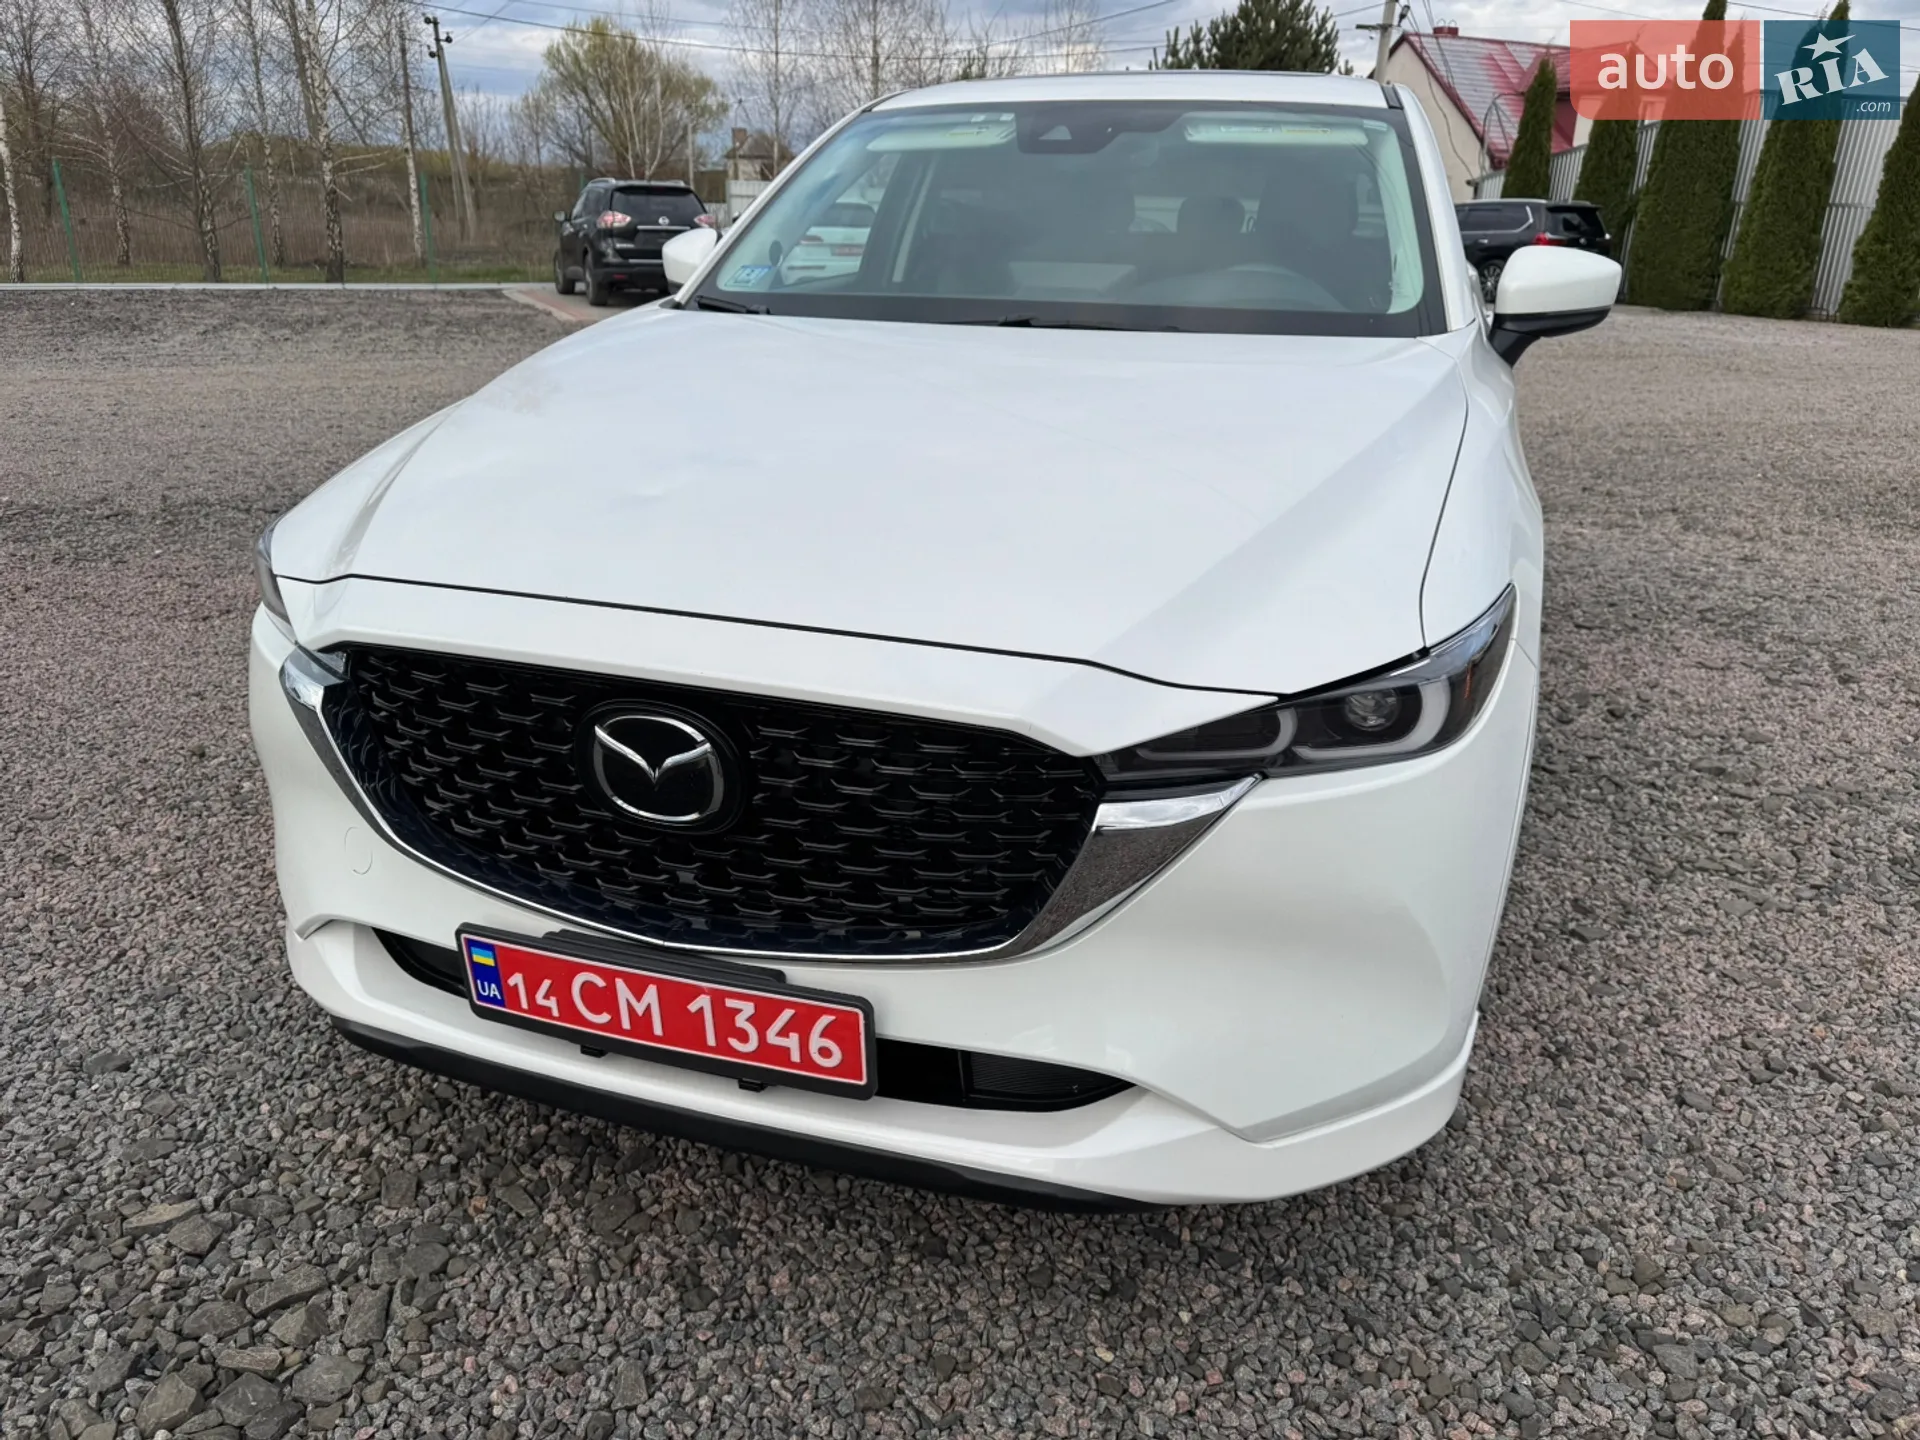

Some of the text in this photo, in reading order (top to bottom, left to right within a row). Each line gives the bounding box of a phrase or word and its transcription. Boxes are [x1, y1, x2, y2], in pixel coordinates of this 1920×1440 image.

[477, 979, 501, 1000] UA
[507, 972, 842, 1068] 14 CM 1346
